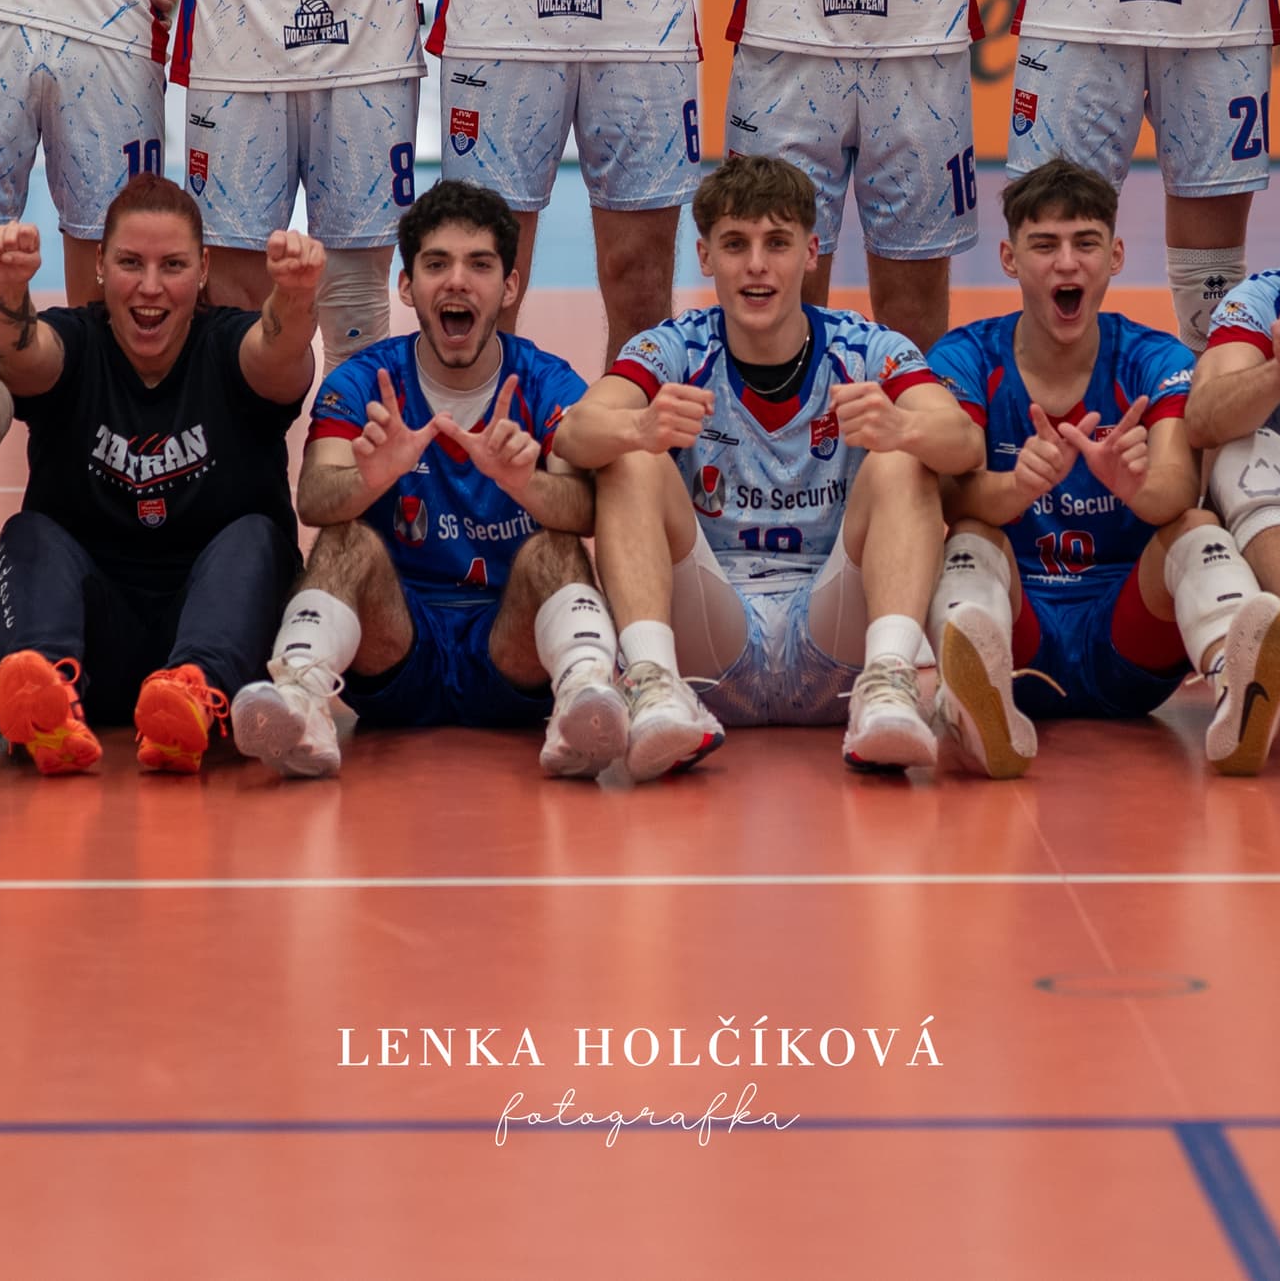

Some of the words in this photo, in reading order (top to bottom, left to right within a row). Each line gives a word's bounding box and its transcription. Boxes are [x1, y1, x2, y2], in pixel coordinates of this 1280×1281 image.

[285, 27, 320, 45] VOLLEY
[320, 22, 346, 40] TEAM
[297, 12, 335, 28] UMB
[389, 142, 415, 207] 8
[91, 424, 208, 482] TATRAN
[736, 485, 763, 510] SG
[771, 478, 848, 511] Security
[437, 514, 459, 540] SG
[464, 510, 537, 542] Securit
[1036, 530, 1096, 575] 10
